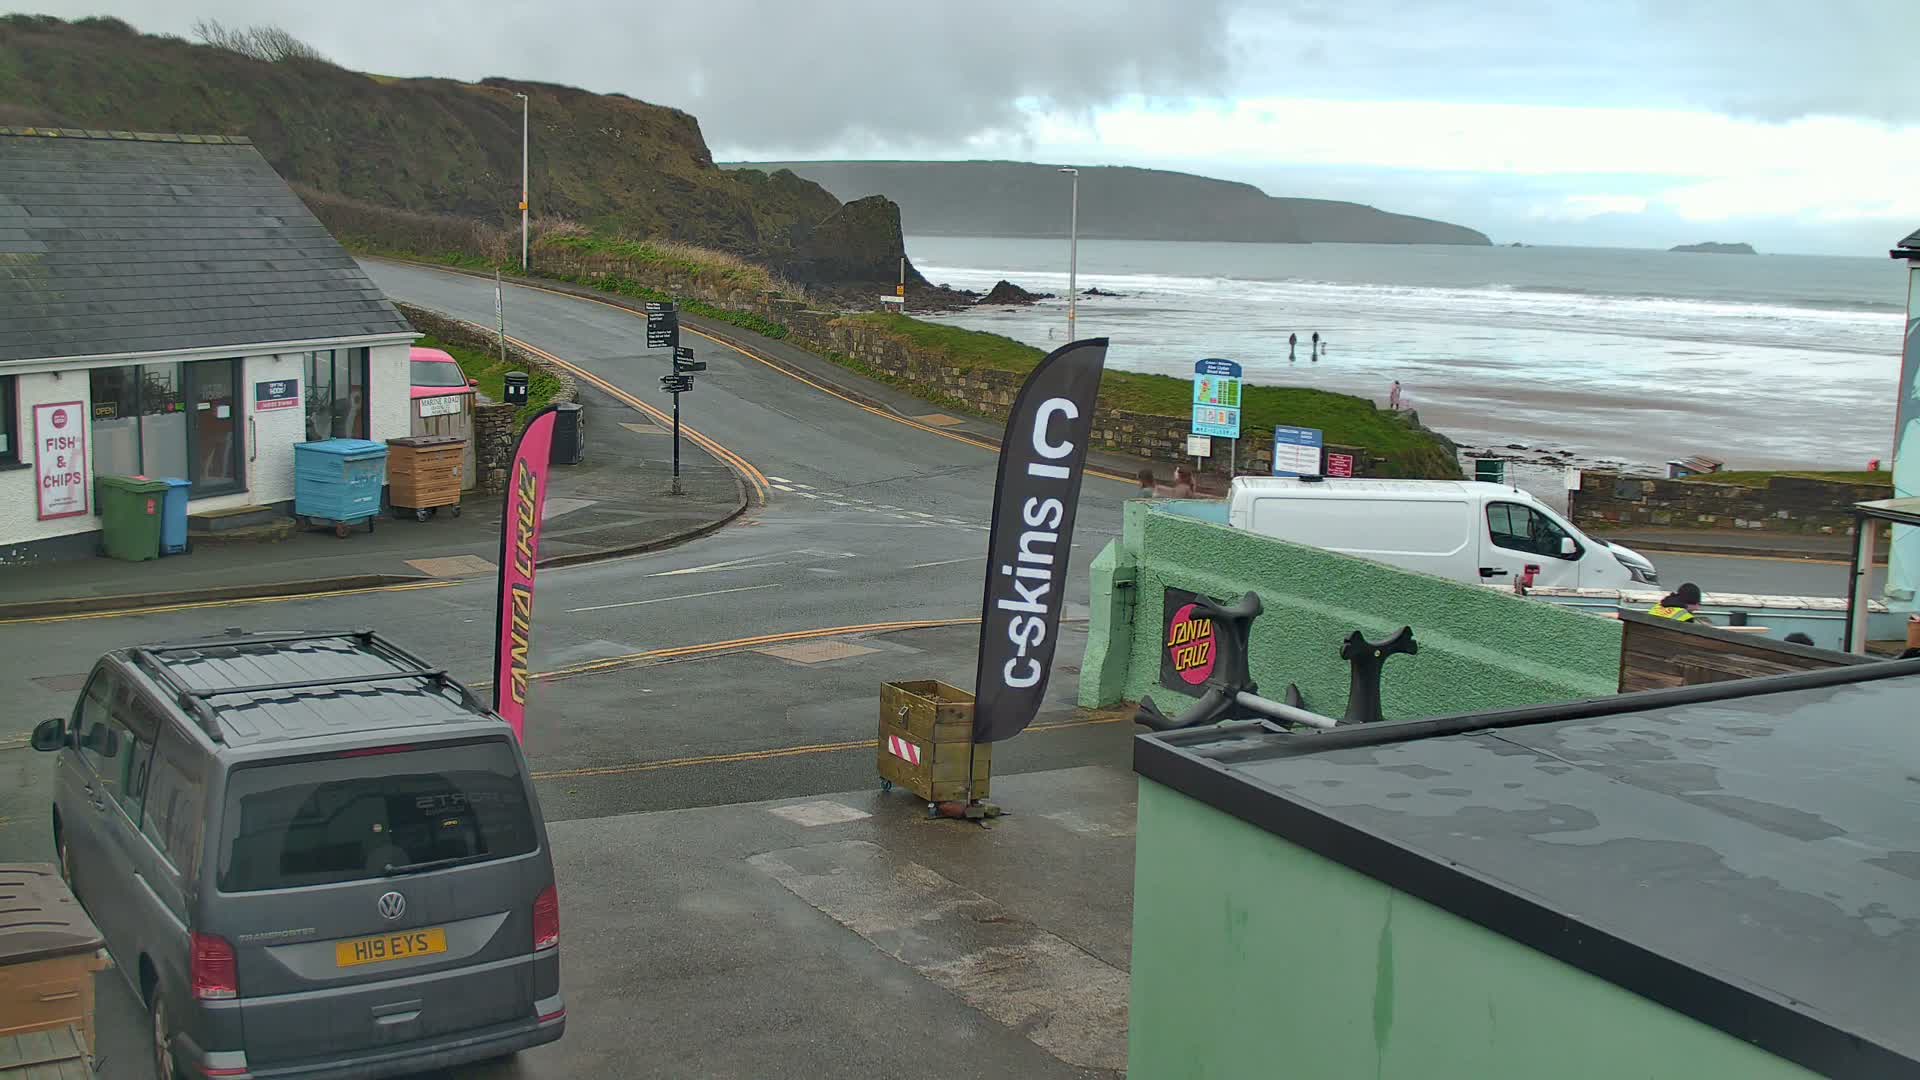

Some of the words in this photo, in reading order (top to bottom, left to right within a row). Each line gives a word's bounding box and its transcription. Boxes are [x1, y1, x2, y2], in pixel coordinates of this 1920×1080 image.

[95, 406, 115, 416] OPEN
[46, 436, 76, 452] FISH
[1028, 397, 1079, 480] IC
[56, 455, 66, 469] &
[43, 472, 81, 488] CHIPS
[514, 458, 537, 580] CRUZ
[998, 497, 1064, 688] c-skins
[1167, 618, 1212, 647] SANTA
[1175, 641, 1210, 671] CRUZ
[239, 927, 316, 944] TRANSPORTER
[354, 940, 386, 960] H19
[391, 933, 429, 956] EYS
